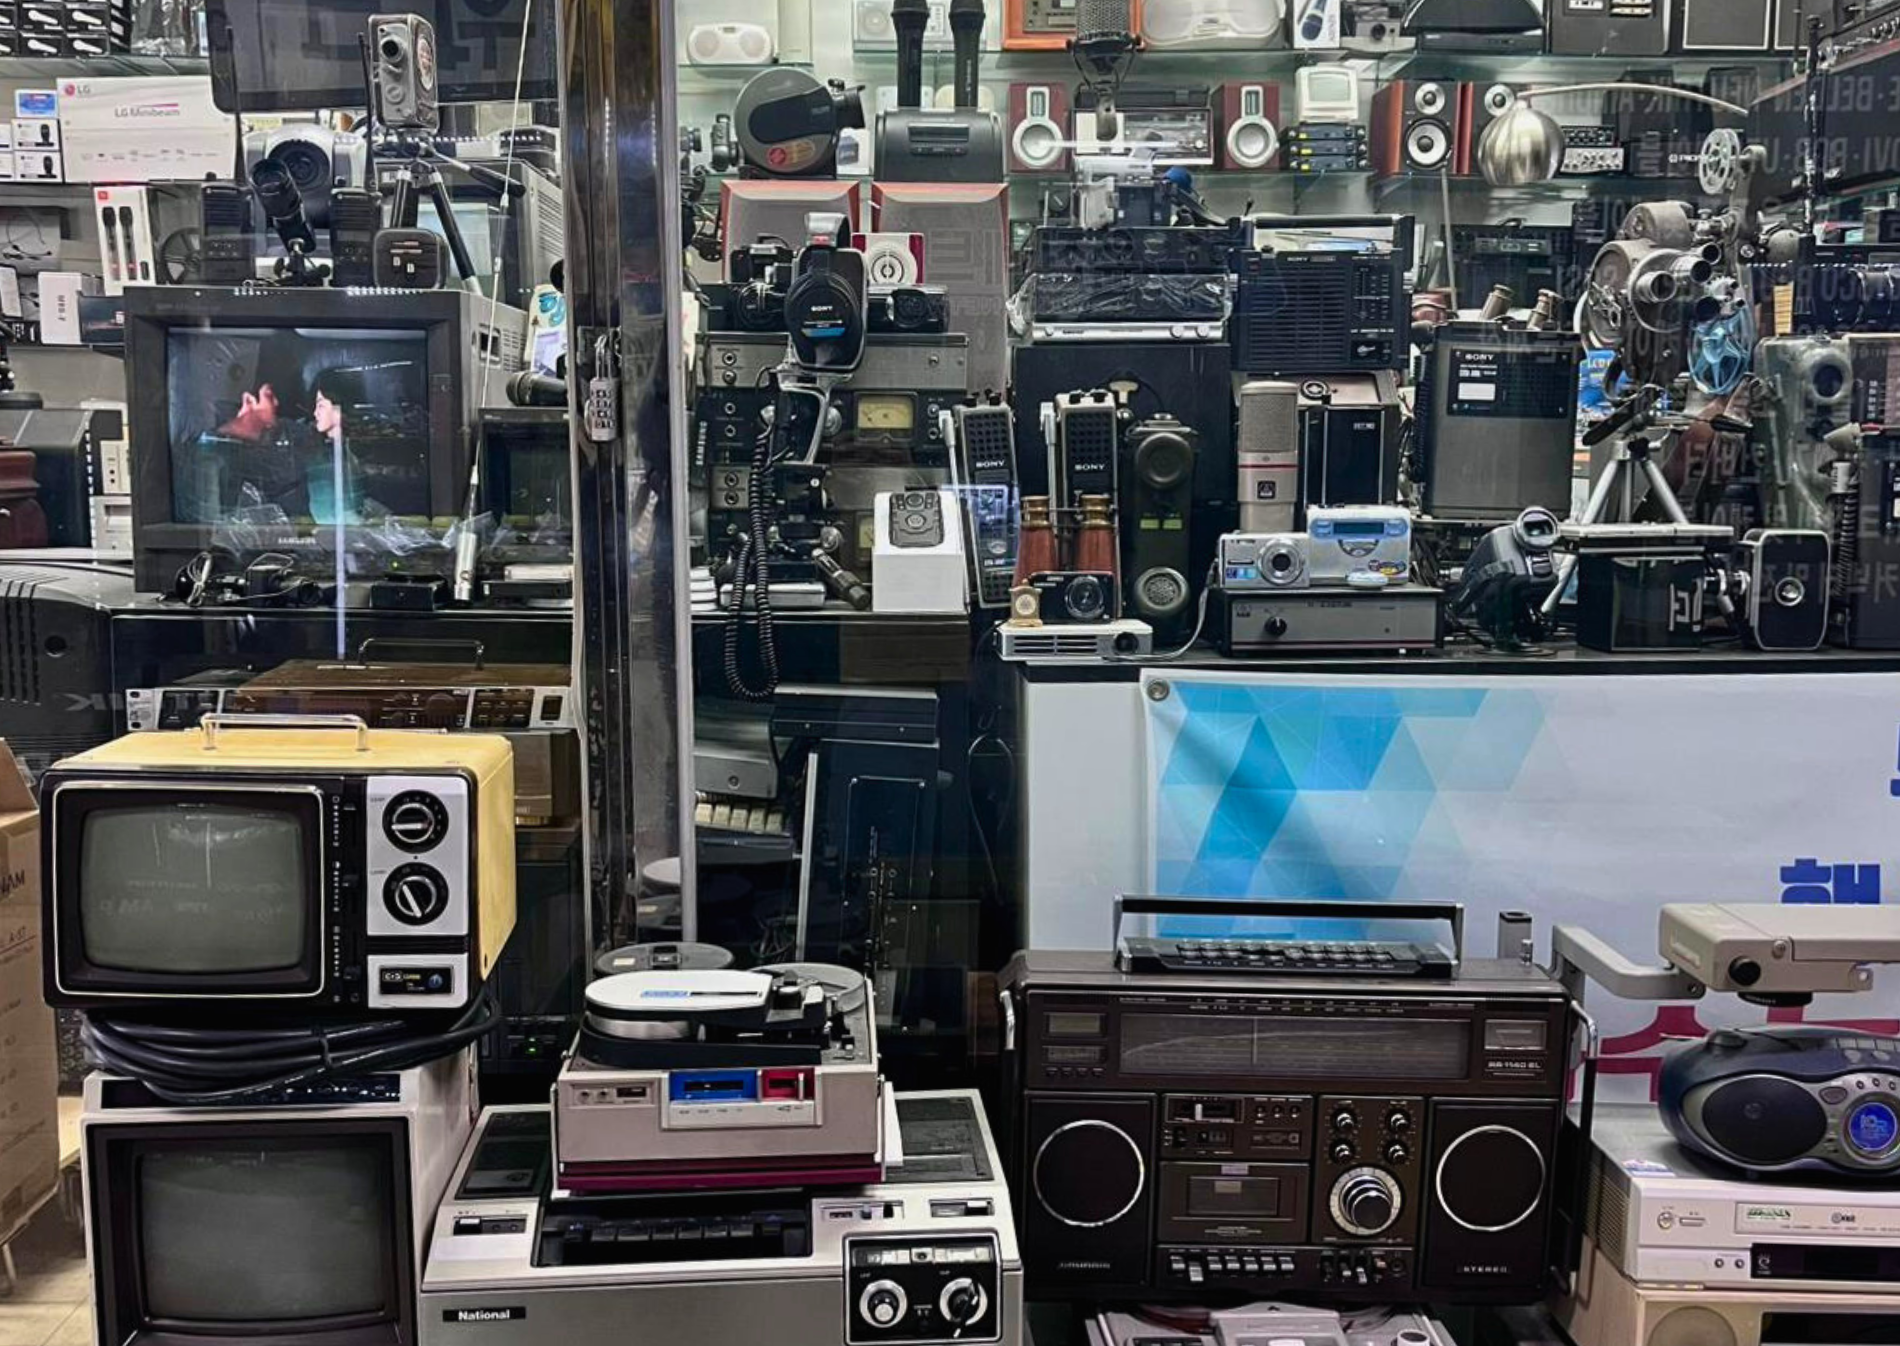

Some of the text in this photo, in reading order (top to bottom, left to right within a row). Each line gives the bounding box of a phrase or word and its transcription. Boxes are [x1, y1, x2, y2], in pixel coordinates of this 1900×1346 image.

[77, 85, 91, 95] LG
[1465, 353, 1495, 361] SONY
[975, 460, 1005, 468] SONY
[1074, 463, 1105, 471] SONY
[1463, 1265, 1507, 1273] STEREO
[458, 1308, 511, 1321] National
